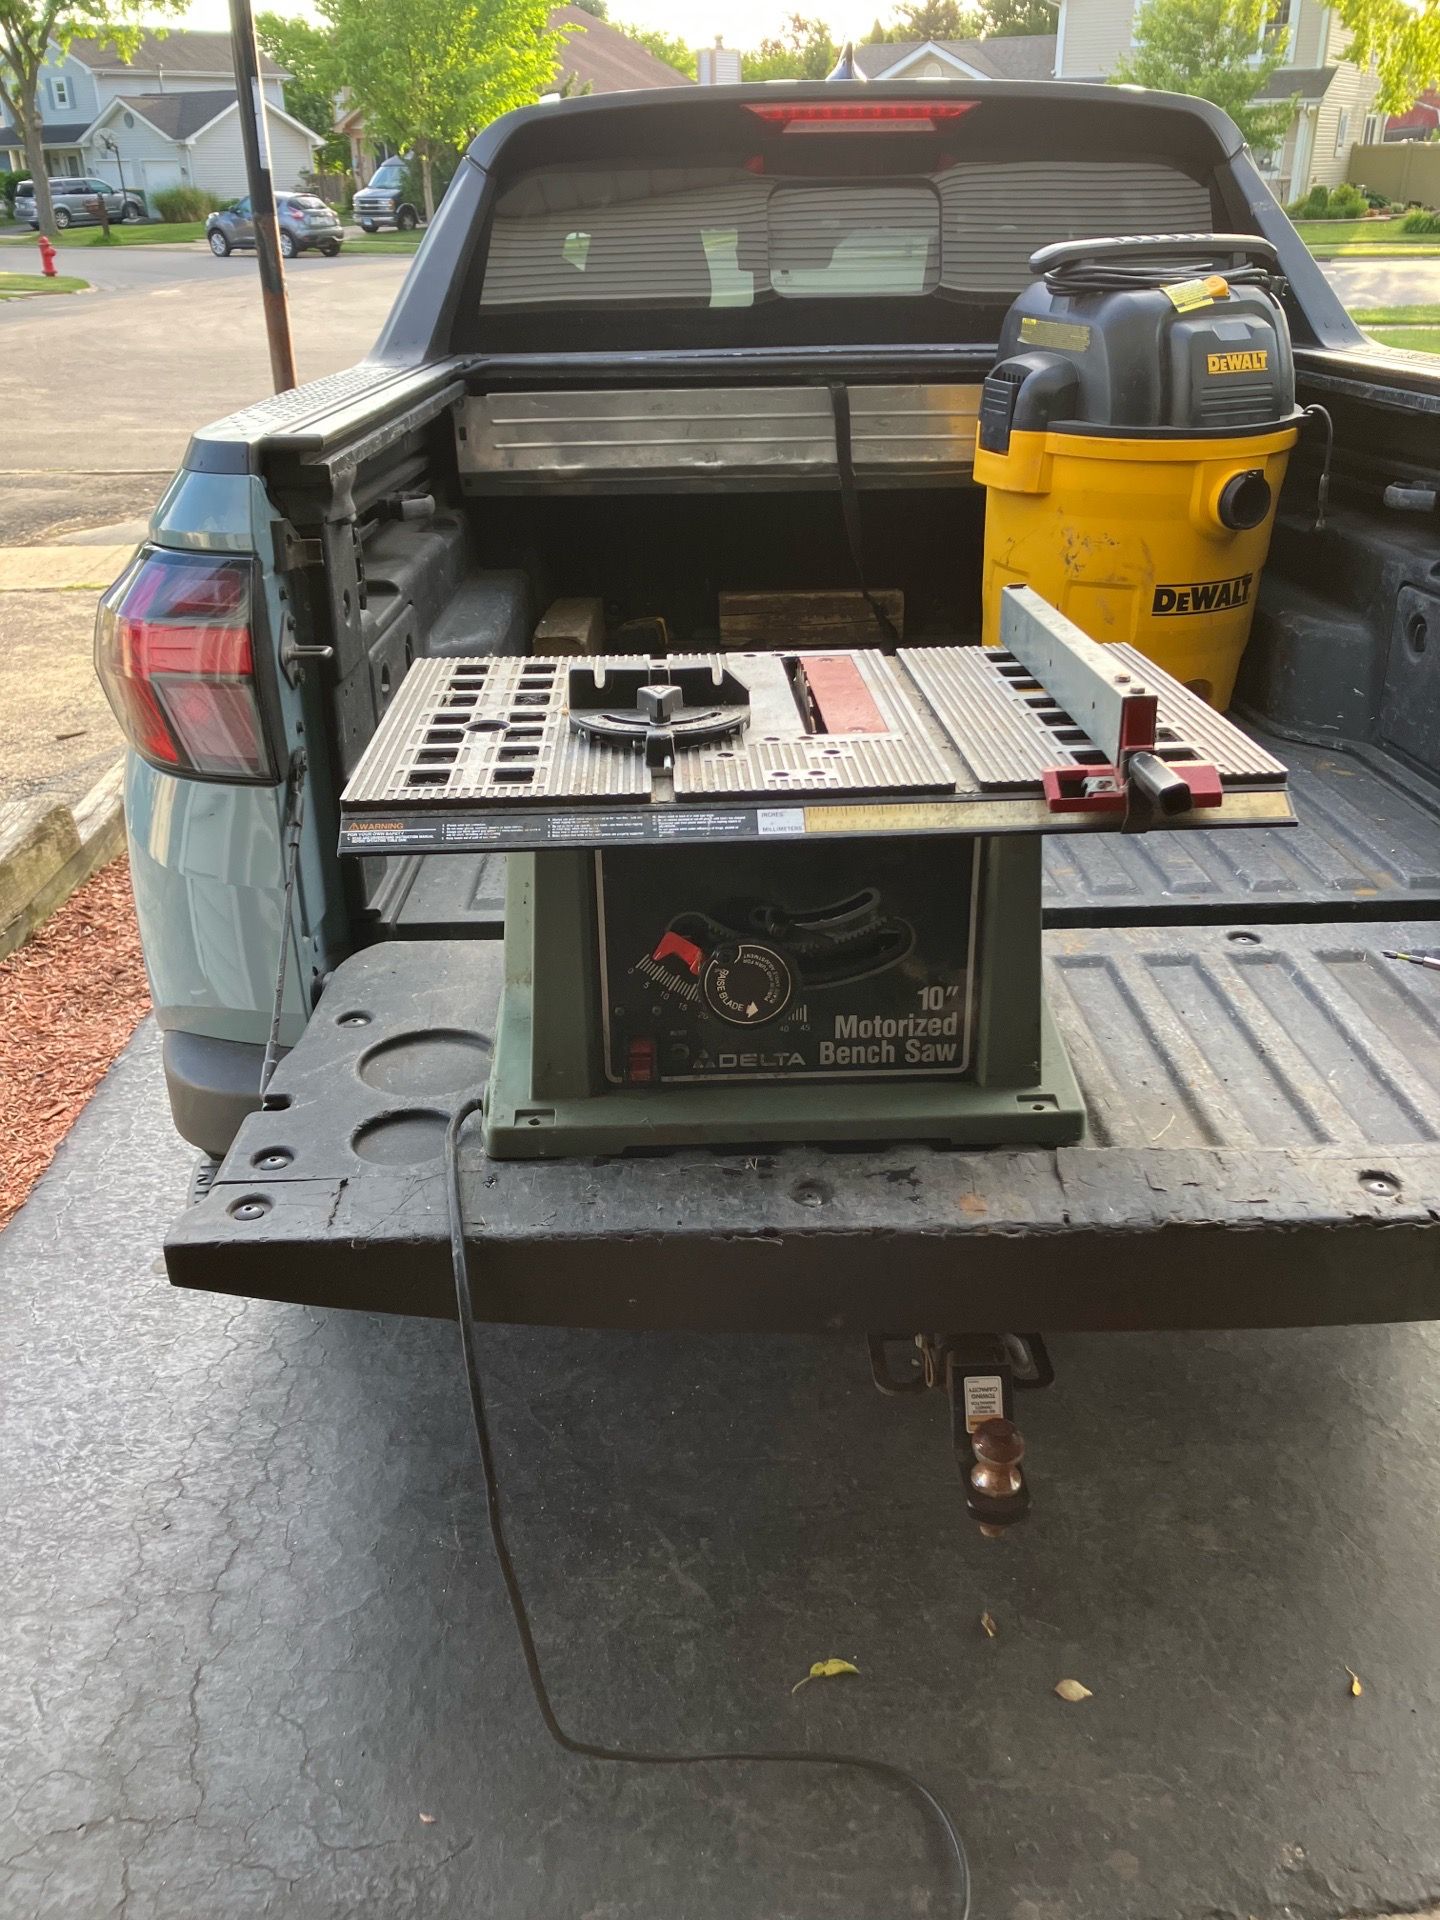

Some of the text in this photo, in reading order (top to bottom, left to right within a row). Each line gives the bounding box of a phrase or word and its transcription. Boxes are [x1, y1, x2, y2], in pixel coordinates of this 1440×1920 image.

[1207, 351, 1268, 373] DEWALT
[1152, 576, 1252, 612] DEWALT
[359, 822, 404, 830] WARNING
[642, 980, 651, 989] 5
[716, 968, 745, 1012] RAISE BLADE
[660, 990, 670, 1000] 10
[678, 1002, 688, 1011] 15
[800, 1024, 810, 1032] 45
[834, 1012, 957, 1039] Motorized
[819, 1038, 957, 1065] Bench Saw
[719, 1052, 807, 1068] DELTA
